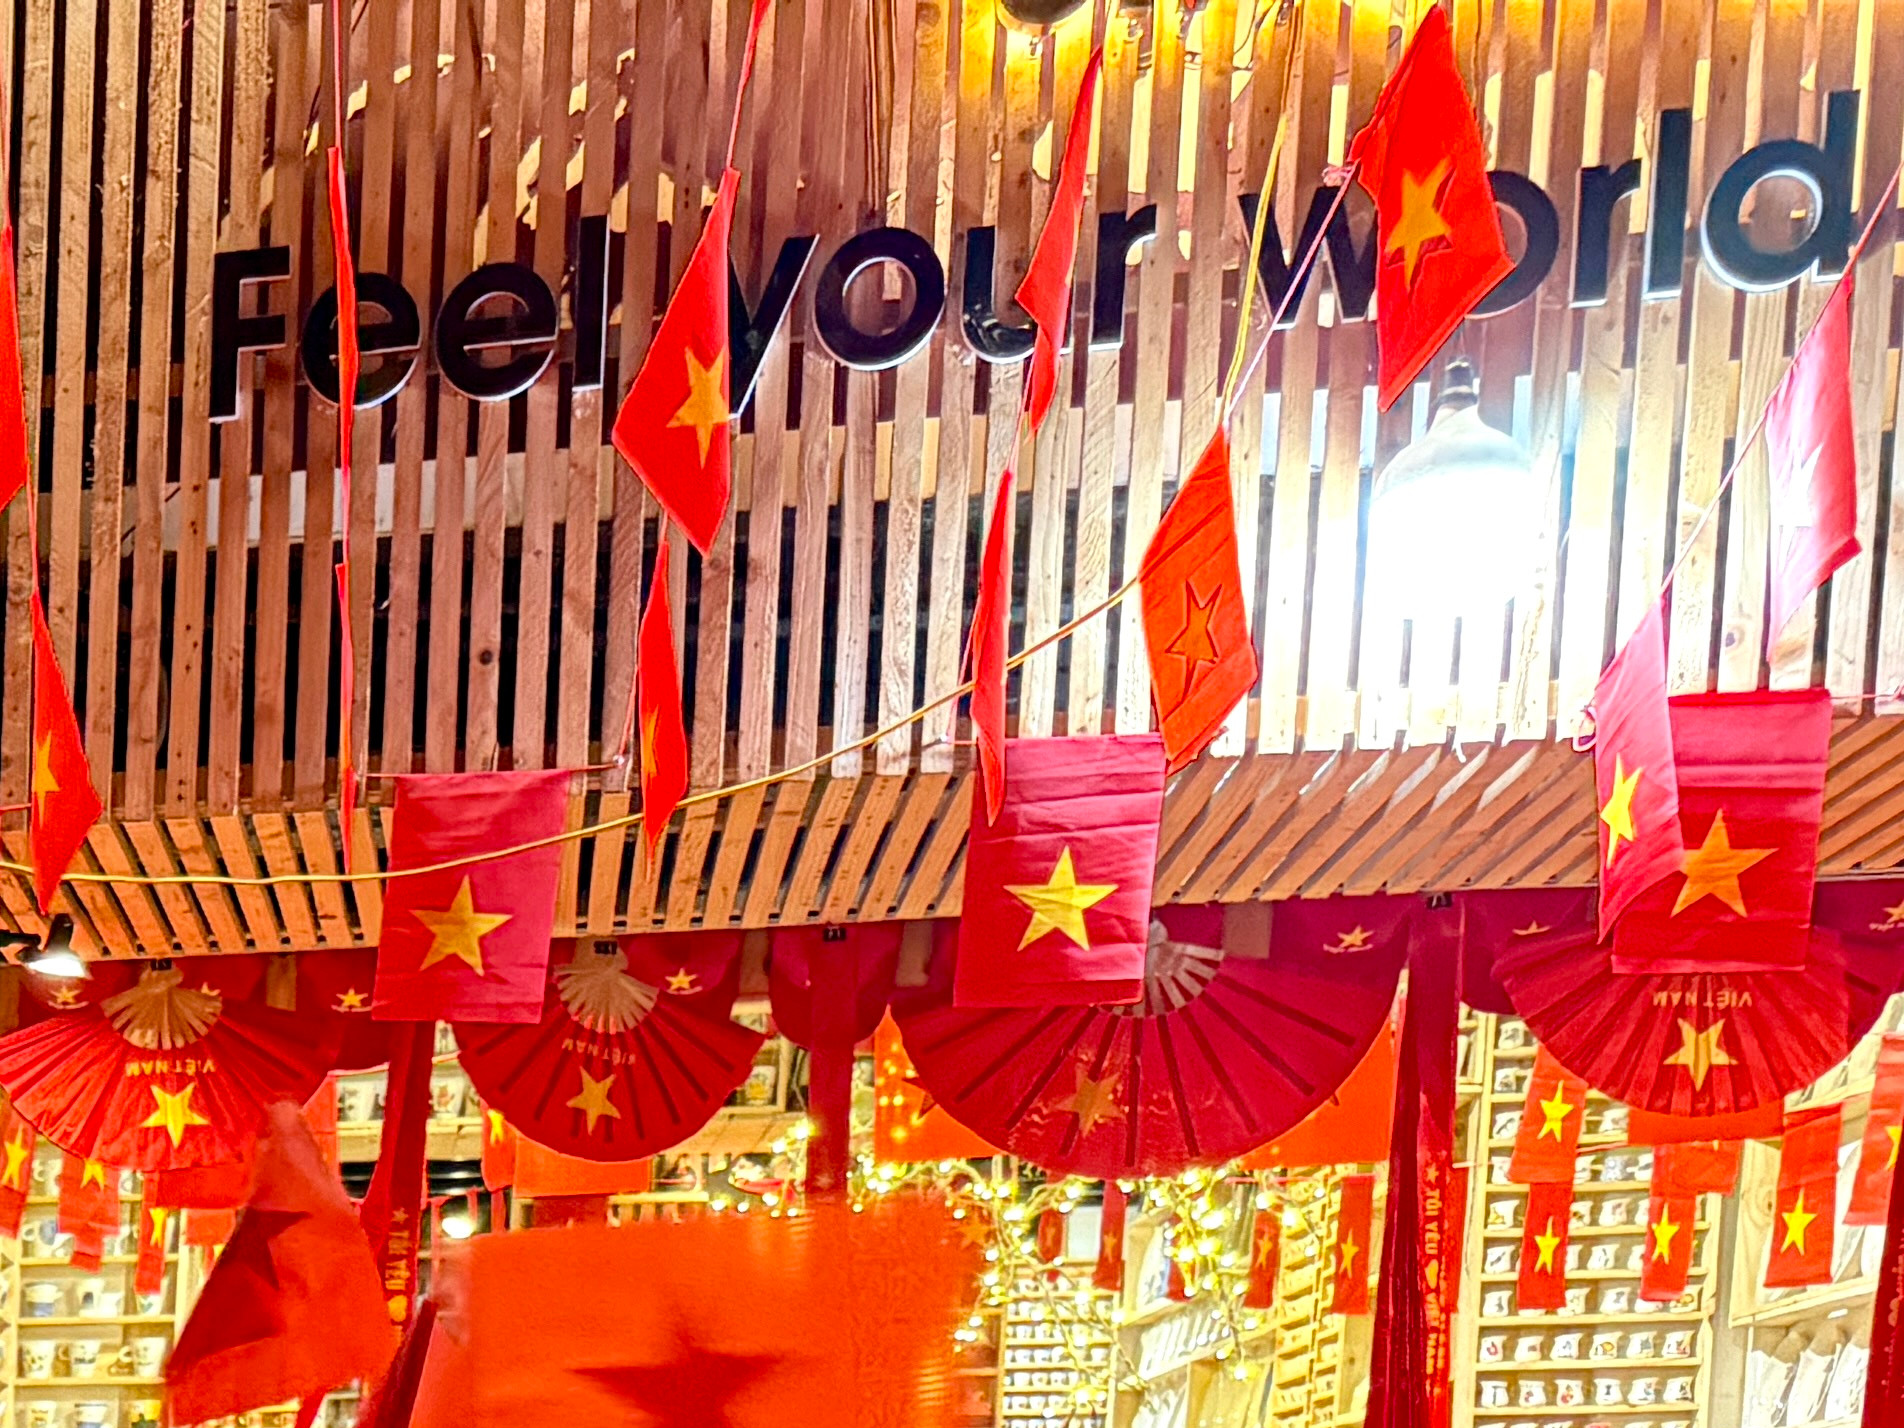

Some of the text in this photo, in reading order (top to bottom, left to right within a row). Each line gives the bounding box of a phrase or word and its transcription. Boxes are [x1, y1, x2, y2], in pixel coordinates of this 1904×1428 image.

[210, 88, 1861, 424] Feel your world
